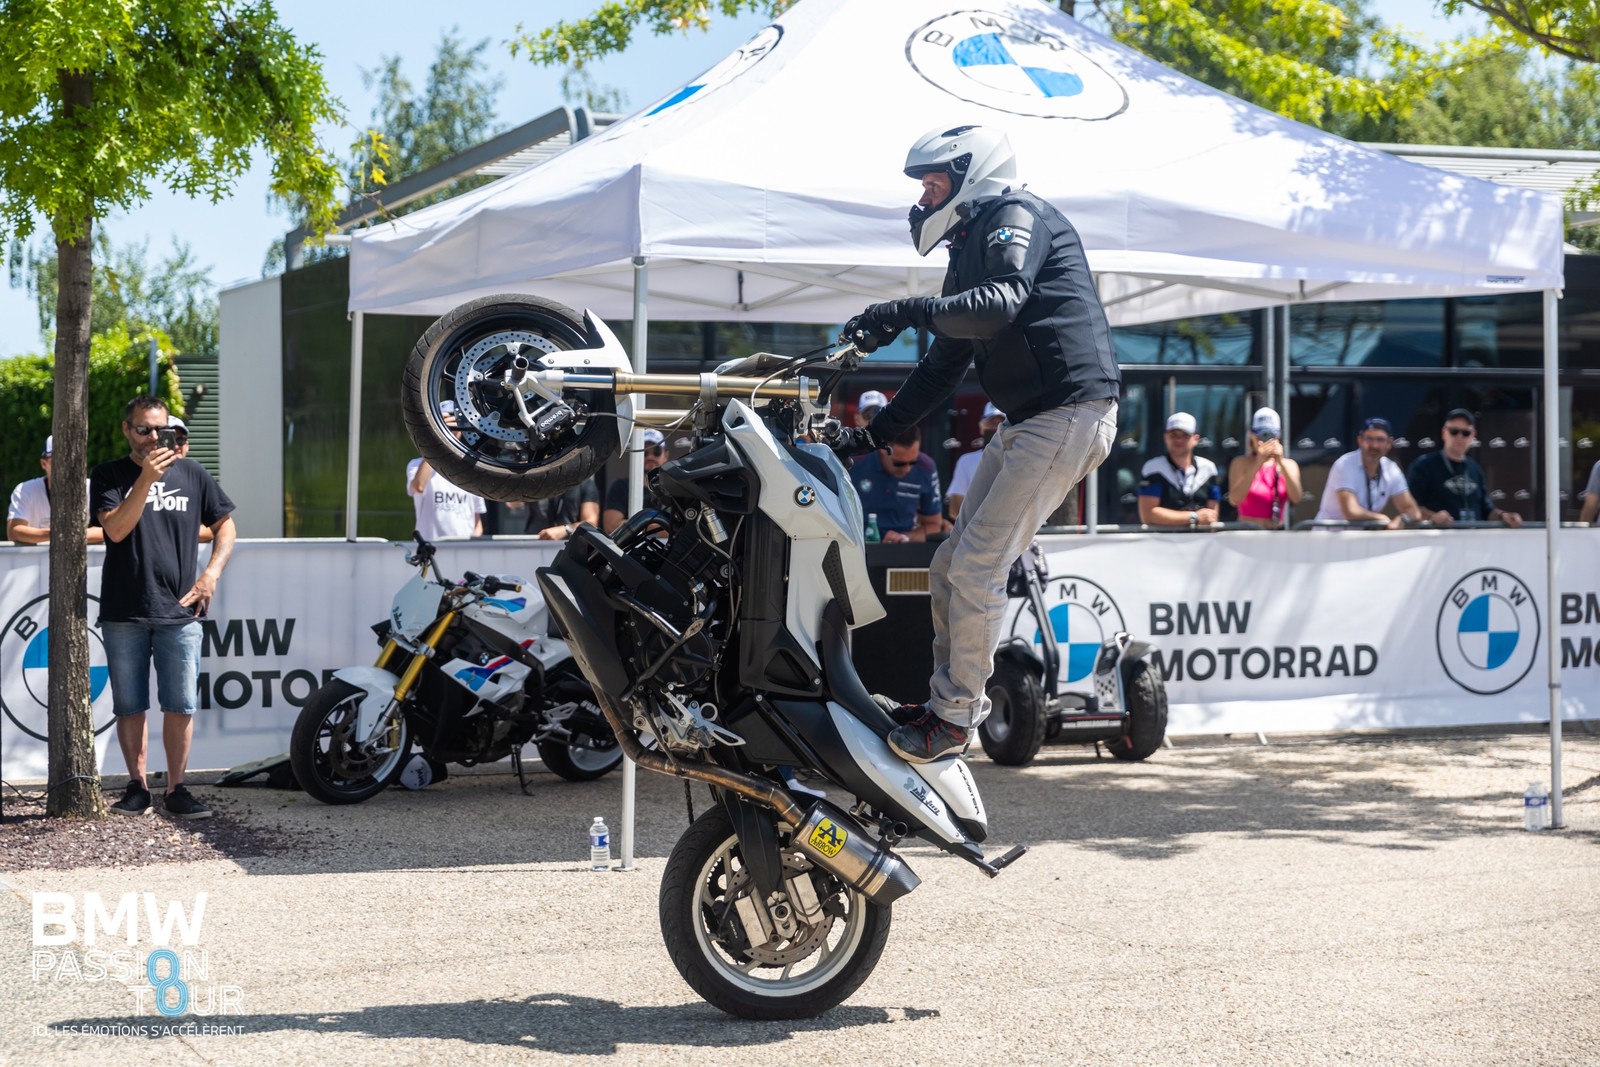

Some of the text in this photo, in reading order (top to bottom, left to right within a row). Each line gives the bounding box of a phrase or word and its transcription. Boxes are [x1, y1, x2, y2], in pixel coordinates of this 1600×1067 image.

[540, 410, 564, 427] brembo
[434, 491, 467, 504] BMW
[1452, 574, 1527, 609] BMW
[1150, 601, 1251, 636] BMW
[200, 618, 296, 658] MW
[1151, 644, 1378, 682] MOTORRAD
[811, 837, 837, 856] ARROW
